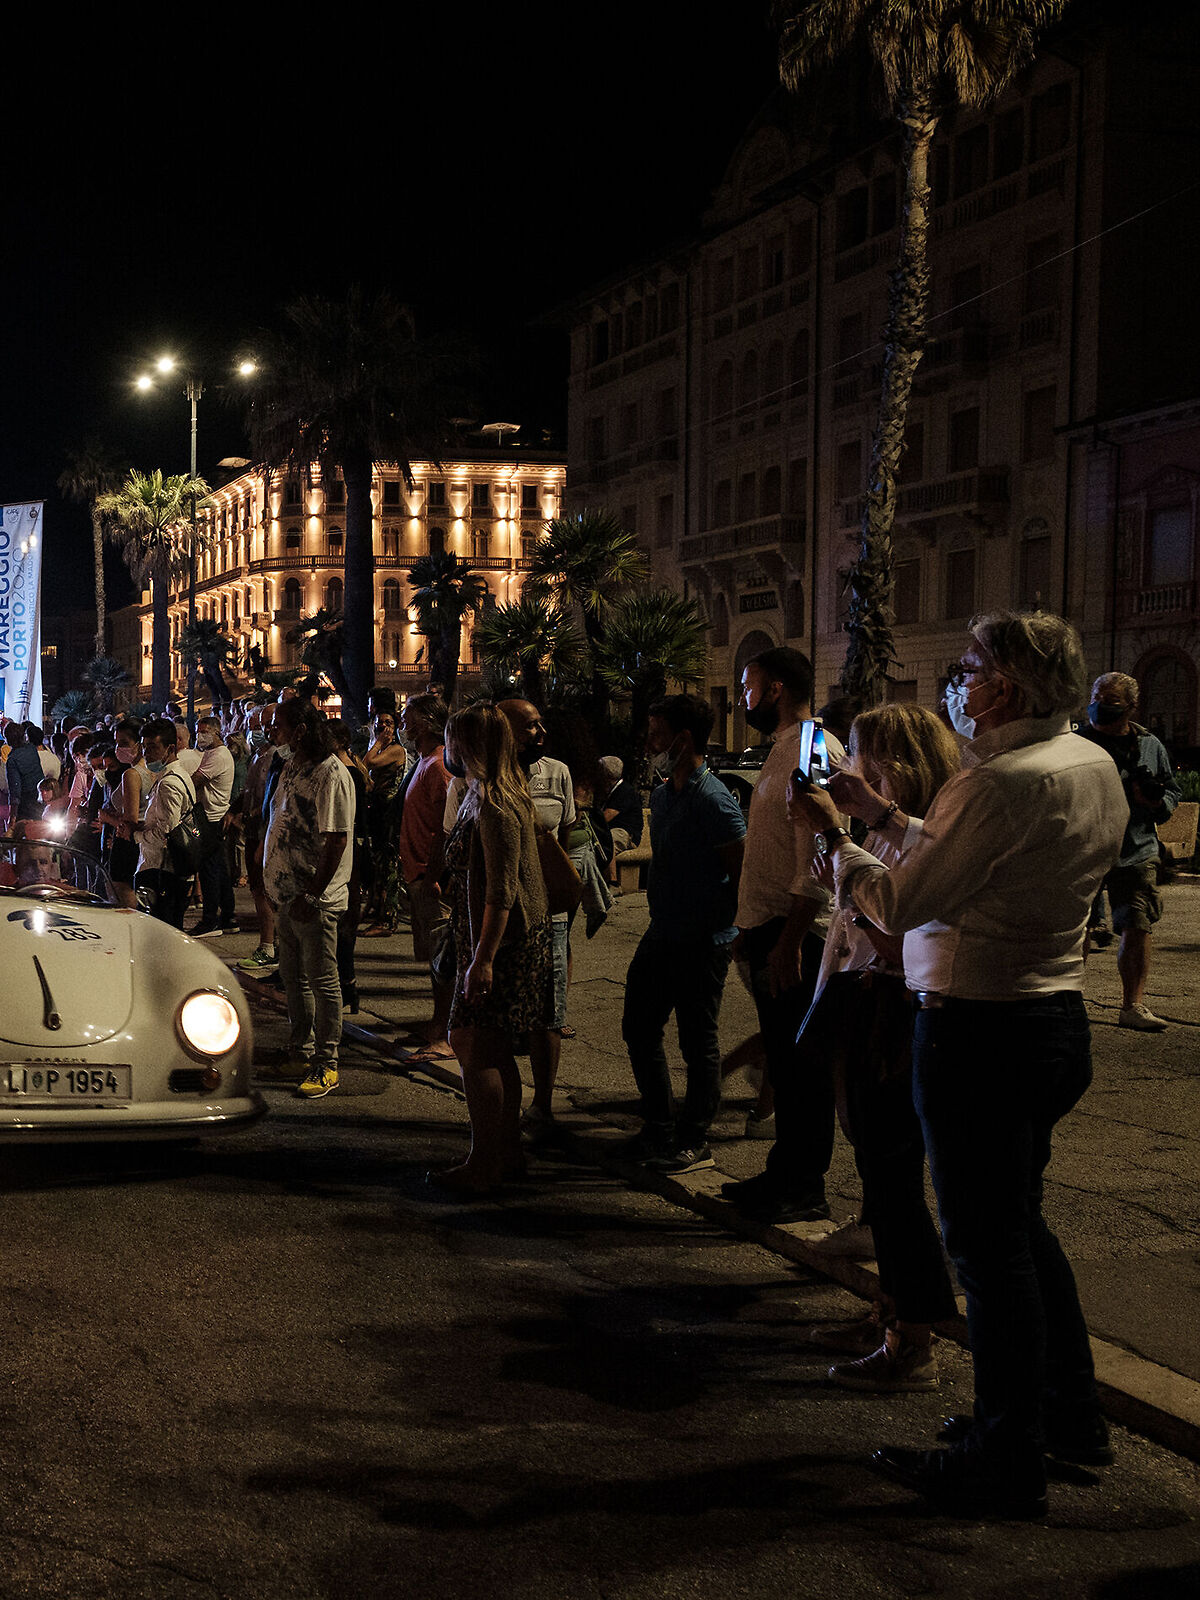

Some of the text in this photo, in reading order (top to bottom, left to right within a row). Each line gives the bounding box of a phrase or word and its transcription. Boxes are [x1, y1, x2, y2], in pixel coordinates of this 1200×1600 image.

[48, 928, 101, 940] 283
[8, 1070, 117, 1093] LI P 1954
